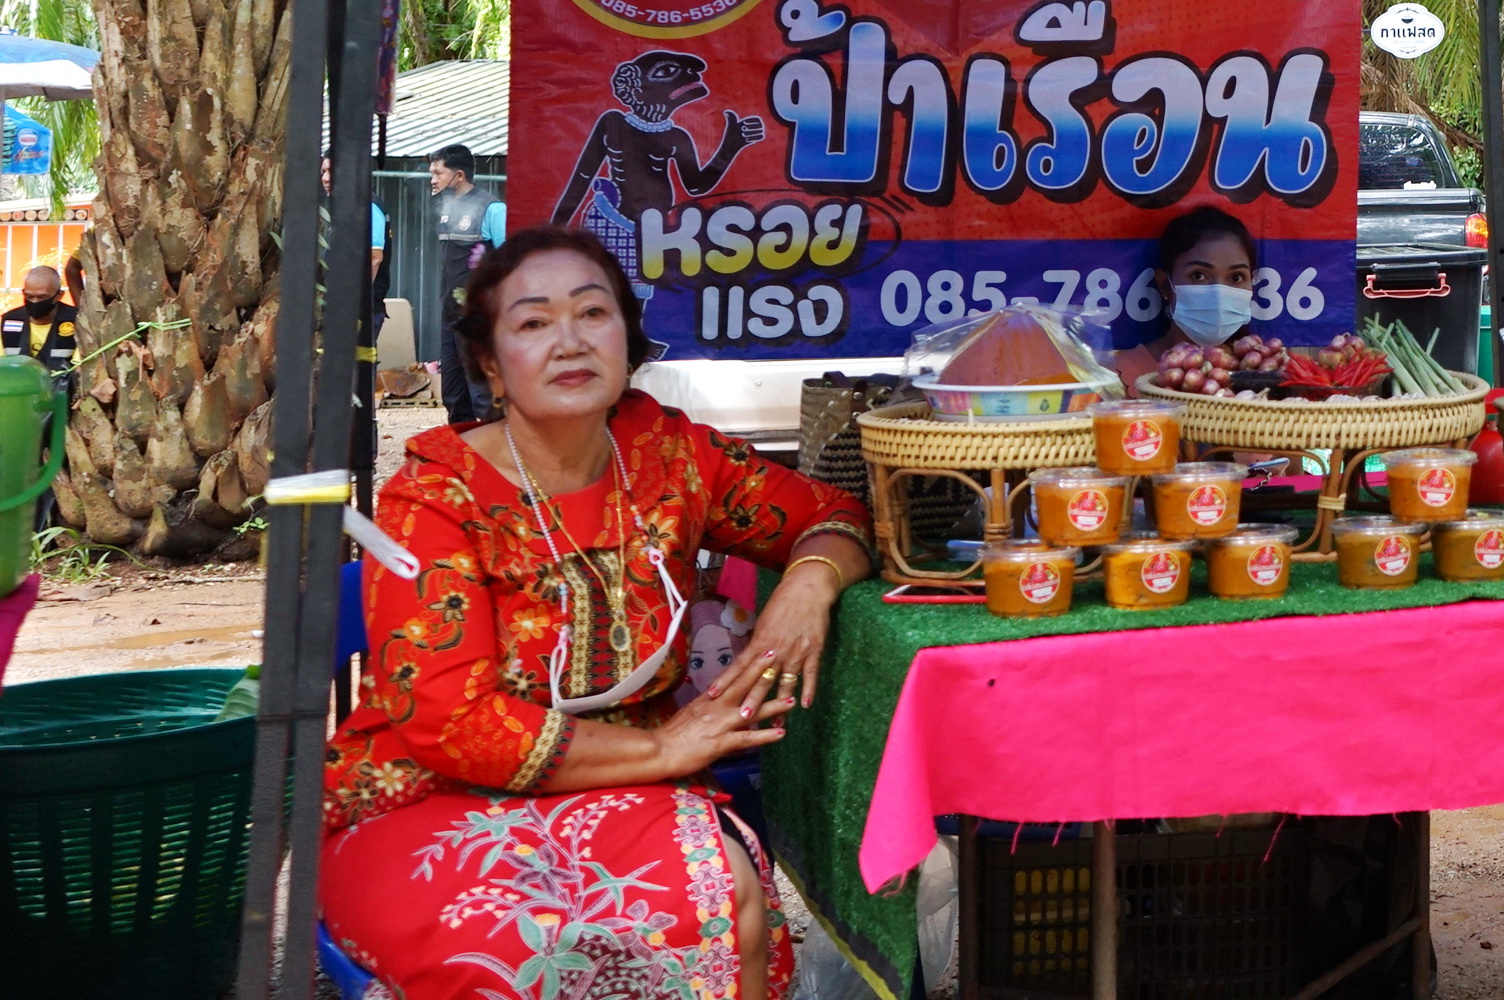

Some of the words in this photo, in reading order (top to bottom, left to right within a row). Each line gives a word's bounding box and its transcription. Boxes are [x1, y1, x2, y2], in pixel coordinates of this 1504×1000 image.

[1381, 25, 1436, 38] กาแฟสด
[642, 204, 862, 279] หรอย
[702, 284, 845, 340] แรง
